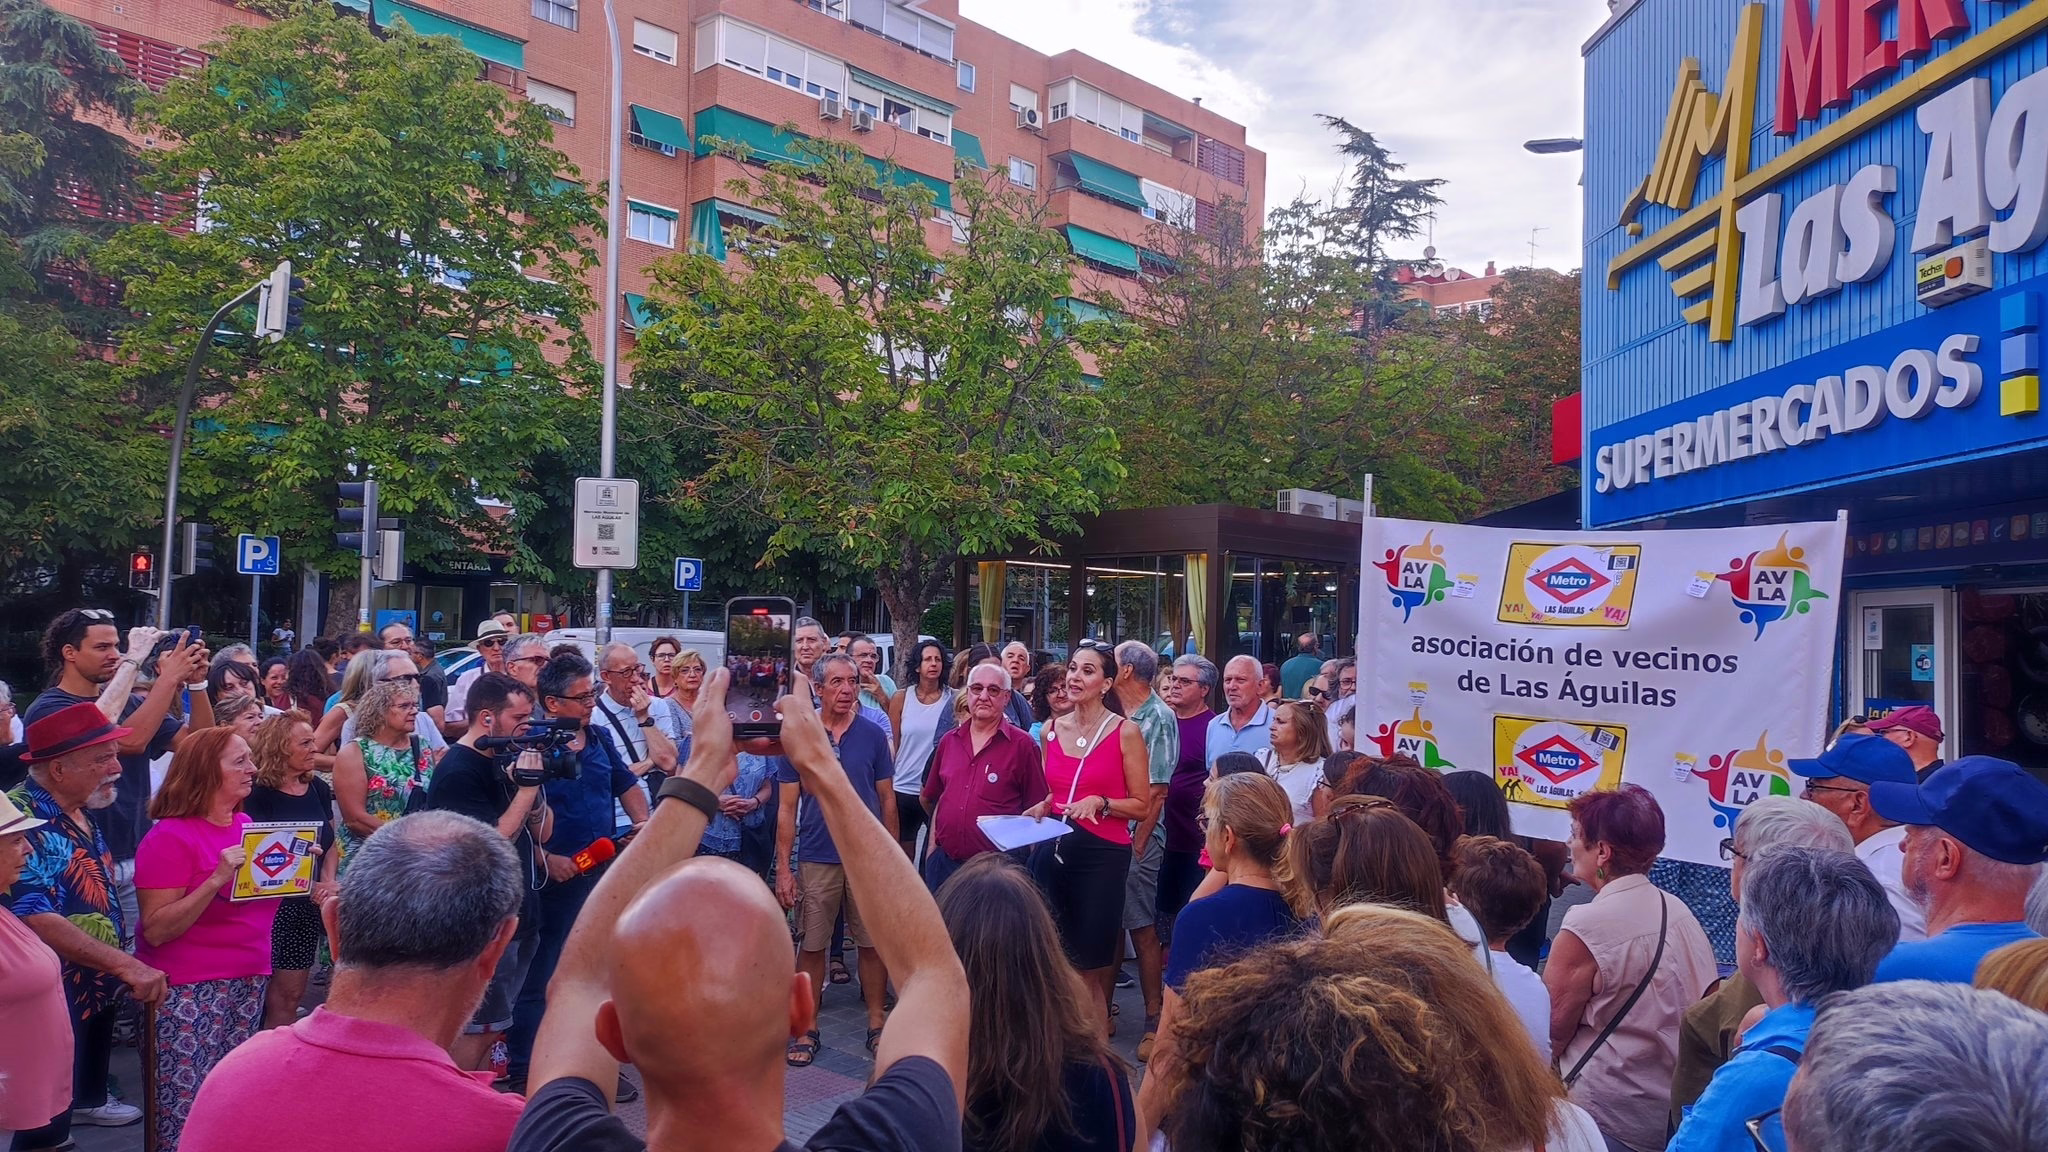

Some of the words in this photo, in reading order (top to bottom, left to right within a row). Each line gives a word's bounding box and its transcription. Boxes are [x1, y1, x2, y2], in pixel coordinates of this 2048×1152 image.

[1736, 163, 1897, 327] Las
[1595, 333, 1982, 493] SUPERMERCADOS
[244, 539, 269, 570] P
[680, 561, 696, 587] P
[1402, 561, 1428, 575] AV
[1404, 576, 1424, 589] LA
[1550, 575, 1587, 586] Metro
[1754, 570, 1788, 585] AV
[1758, 587, 1786, 601] LA
[1504, 604, 1524, 613] YA!
[1544, 605, 1557, 614] LAS
[1604, 606, 1627, 622] YA!
[1411, 635, 1553, 664] asociación
[1564, 643, 1602, 667] de
[1613, 647, 1738, 674] vecinos
[1457, 670, 1490, 694] de
[1500, 673, 1549, 699] Las
[1558, 671, 1677, 708] Águilas
[1397, 738, 1421, 752] AV
[1539, 752, 1576, 767] Metro
[1499, 766, 1519, 777] YA!
[1731, 771, 1765, 788] AV
[1536, 784, 1548, 795] LAS
